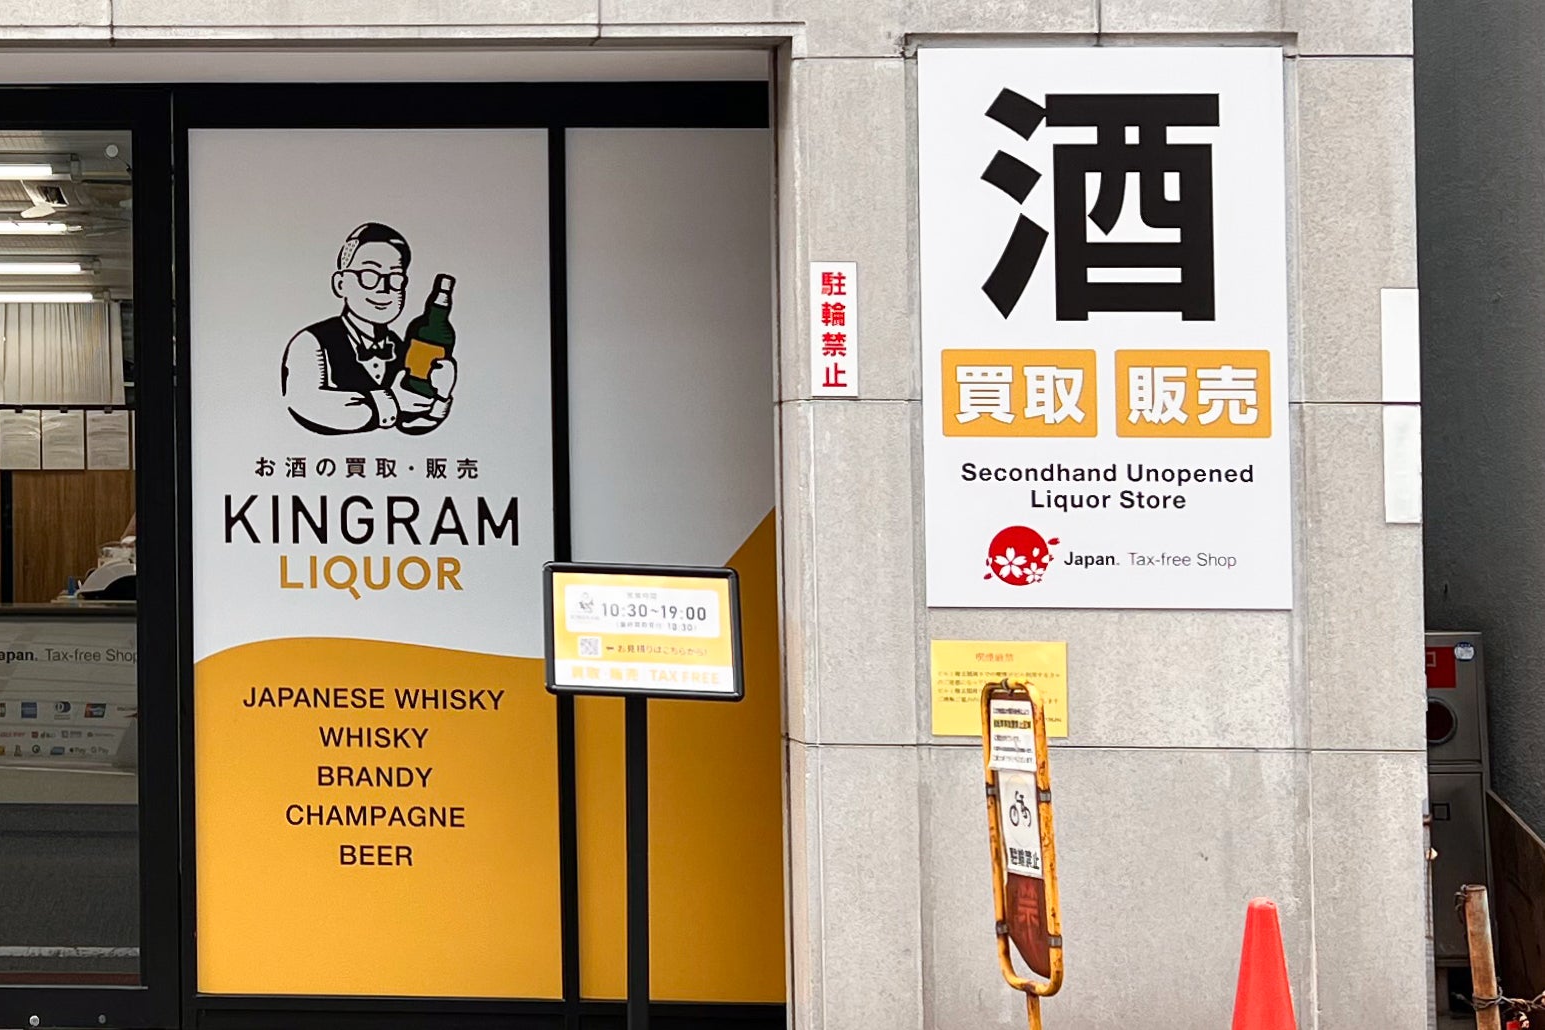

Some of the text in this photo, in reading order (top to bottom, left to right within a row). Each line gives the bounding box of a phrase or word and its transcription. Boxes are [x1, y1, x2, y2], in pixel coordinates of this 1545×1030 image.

[980, 87, 1220, 322] 酒
[821, 271, 848, 389] 駐輪禁止
[955, 363, 1258, 425] 買取 販売
[254, 456, 479, 480] お酒の買取・販売
[961, 463, 1254, 486] Secondhand Unopened
[1030, 490, 1187, 512] Liquor Store
[224, 493, 520, 547] KINGRAM
[1127, 552, 1191, 566] Tax-free
[1197, 552, 1237, 569] Shop
[280, 555, 464, 600] LIQUOR
[45, 648, 101, 662] Tax-free
[243, 686, 505, 710] JAPANESE WHISKY
[319, 726, 429, 748] WHISKY
[317, 765, 433, 788] BRANDY
[285, 804, 465, 828] CHAMPAGNE
[339, 845, 413, 866] BEER
